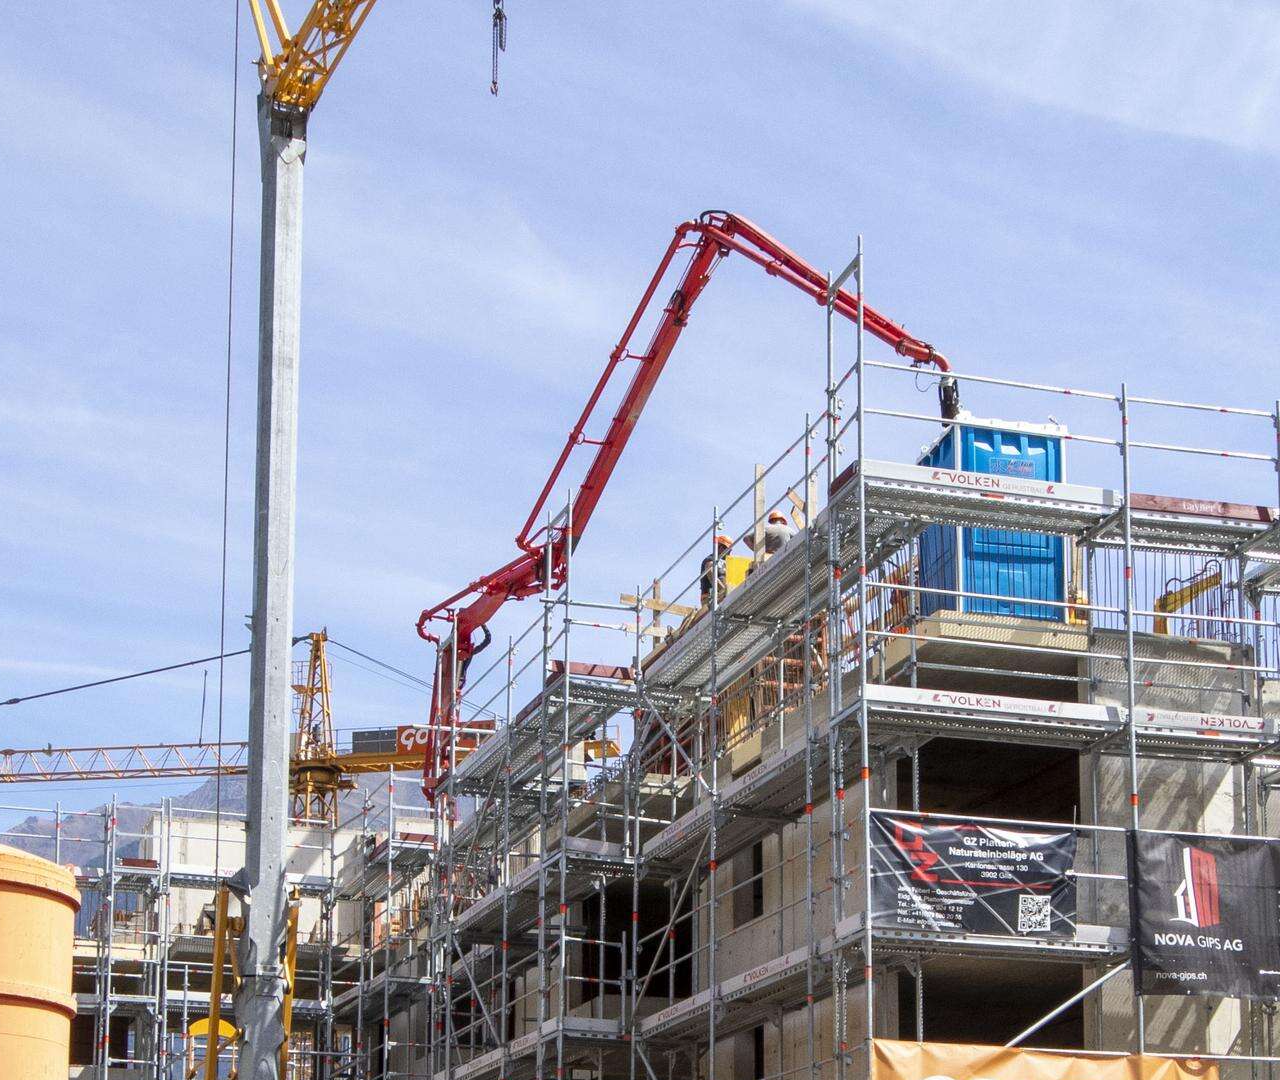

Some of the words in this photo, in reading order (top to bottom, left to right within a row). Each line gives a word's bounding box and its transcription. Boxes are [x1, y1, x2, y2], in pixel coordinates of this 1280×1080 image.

[948, 473, 1000, 488] VOLKEN
[949, 695, 1001, 708] VOLKEN
[1201, 717, 1249, 728] VOLKEN
[963, 837, 977, 846] GZ
[948, 847, 1027, 861] Natursteinbeläge
[1029, 852, 1044, 861] AG
[1154, 933, 1194, 947] NOVA
[1197, 936, 1221, 949] GIPS
[1223, 938, 1243, 951] AG
[1156, 971, 1207, 982] nova-gips.ch
